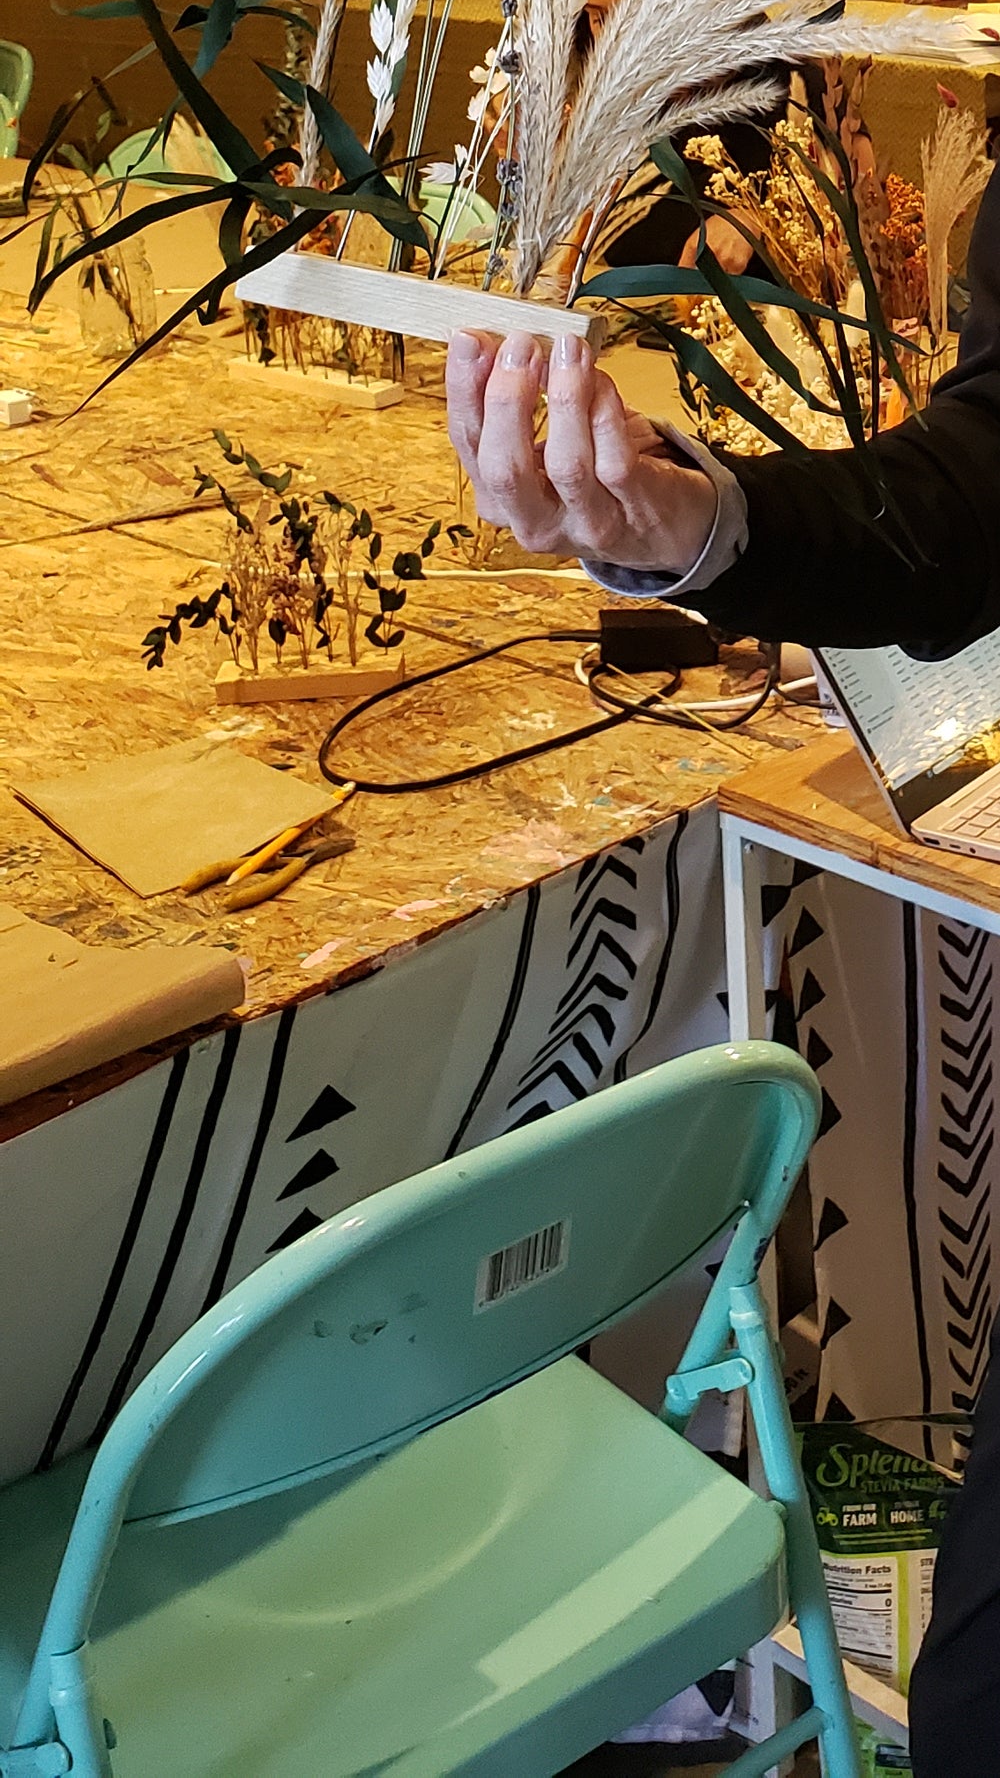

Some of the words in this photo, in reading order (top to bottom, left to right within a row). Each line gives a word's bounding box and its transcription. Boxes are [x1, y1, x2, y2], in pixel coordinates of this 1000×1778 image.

[816, 1443, 939, 1488] Splen
[843, 1513, 877, 1526] FARM
[890, 1509, 924, 1523] HOME
[865, 1565, 891, 1574] Facts
[885, 1598, 892, 1607] 0
